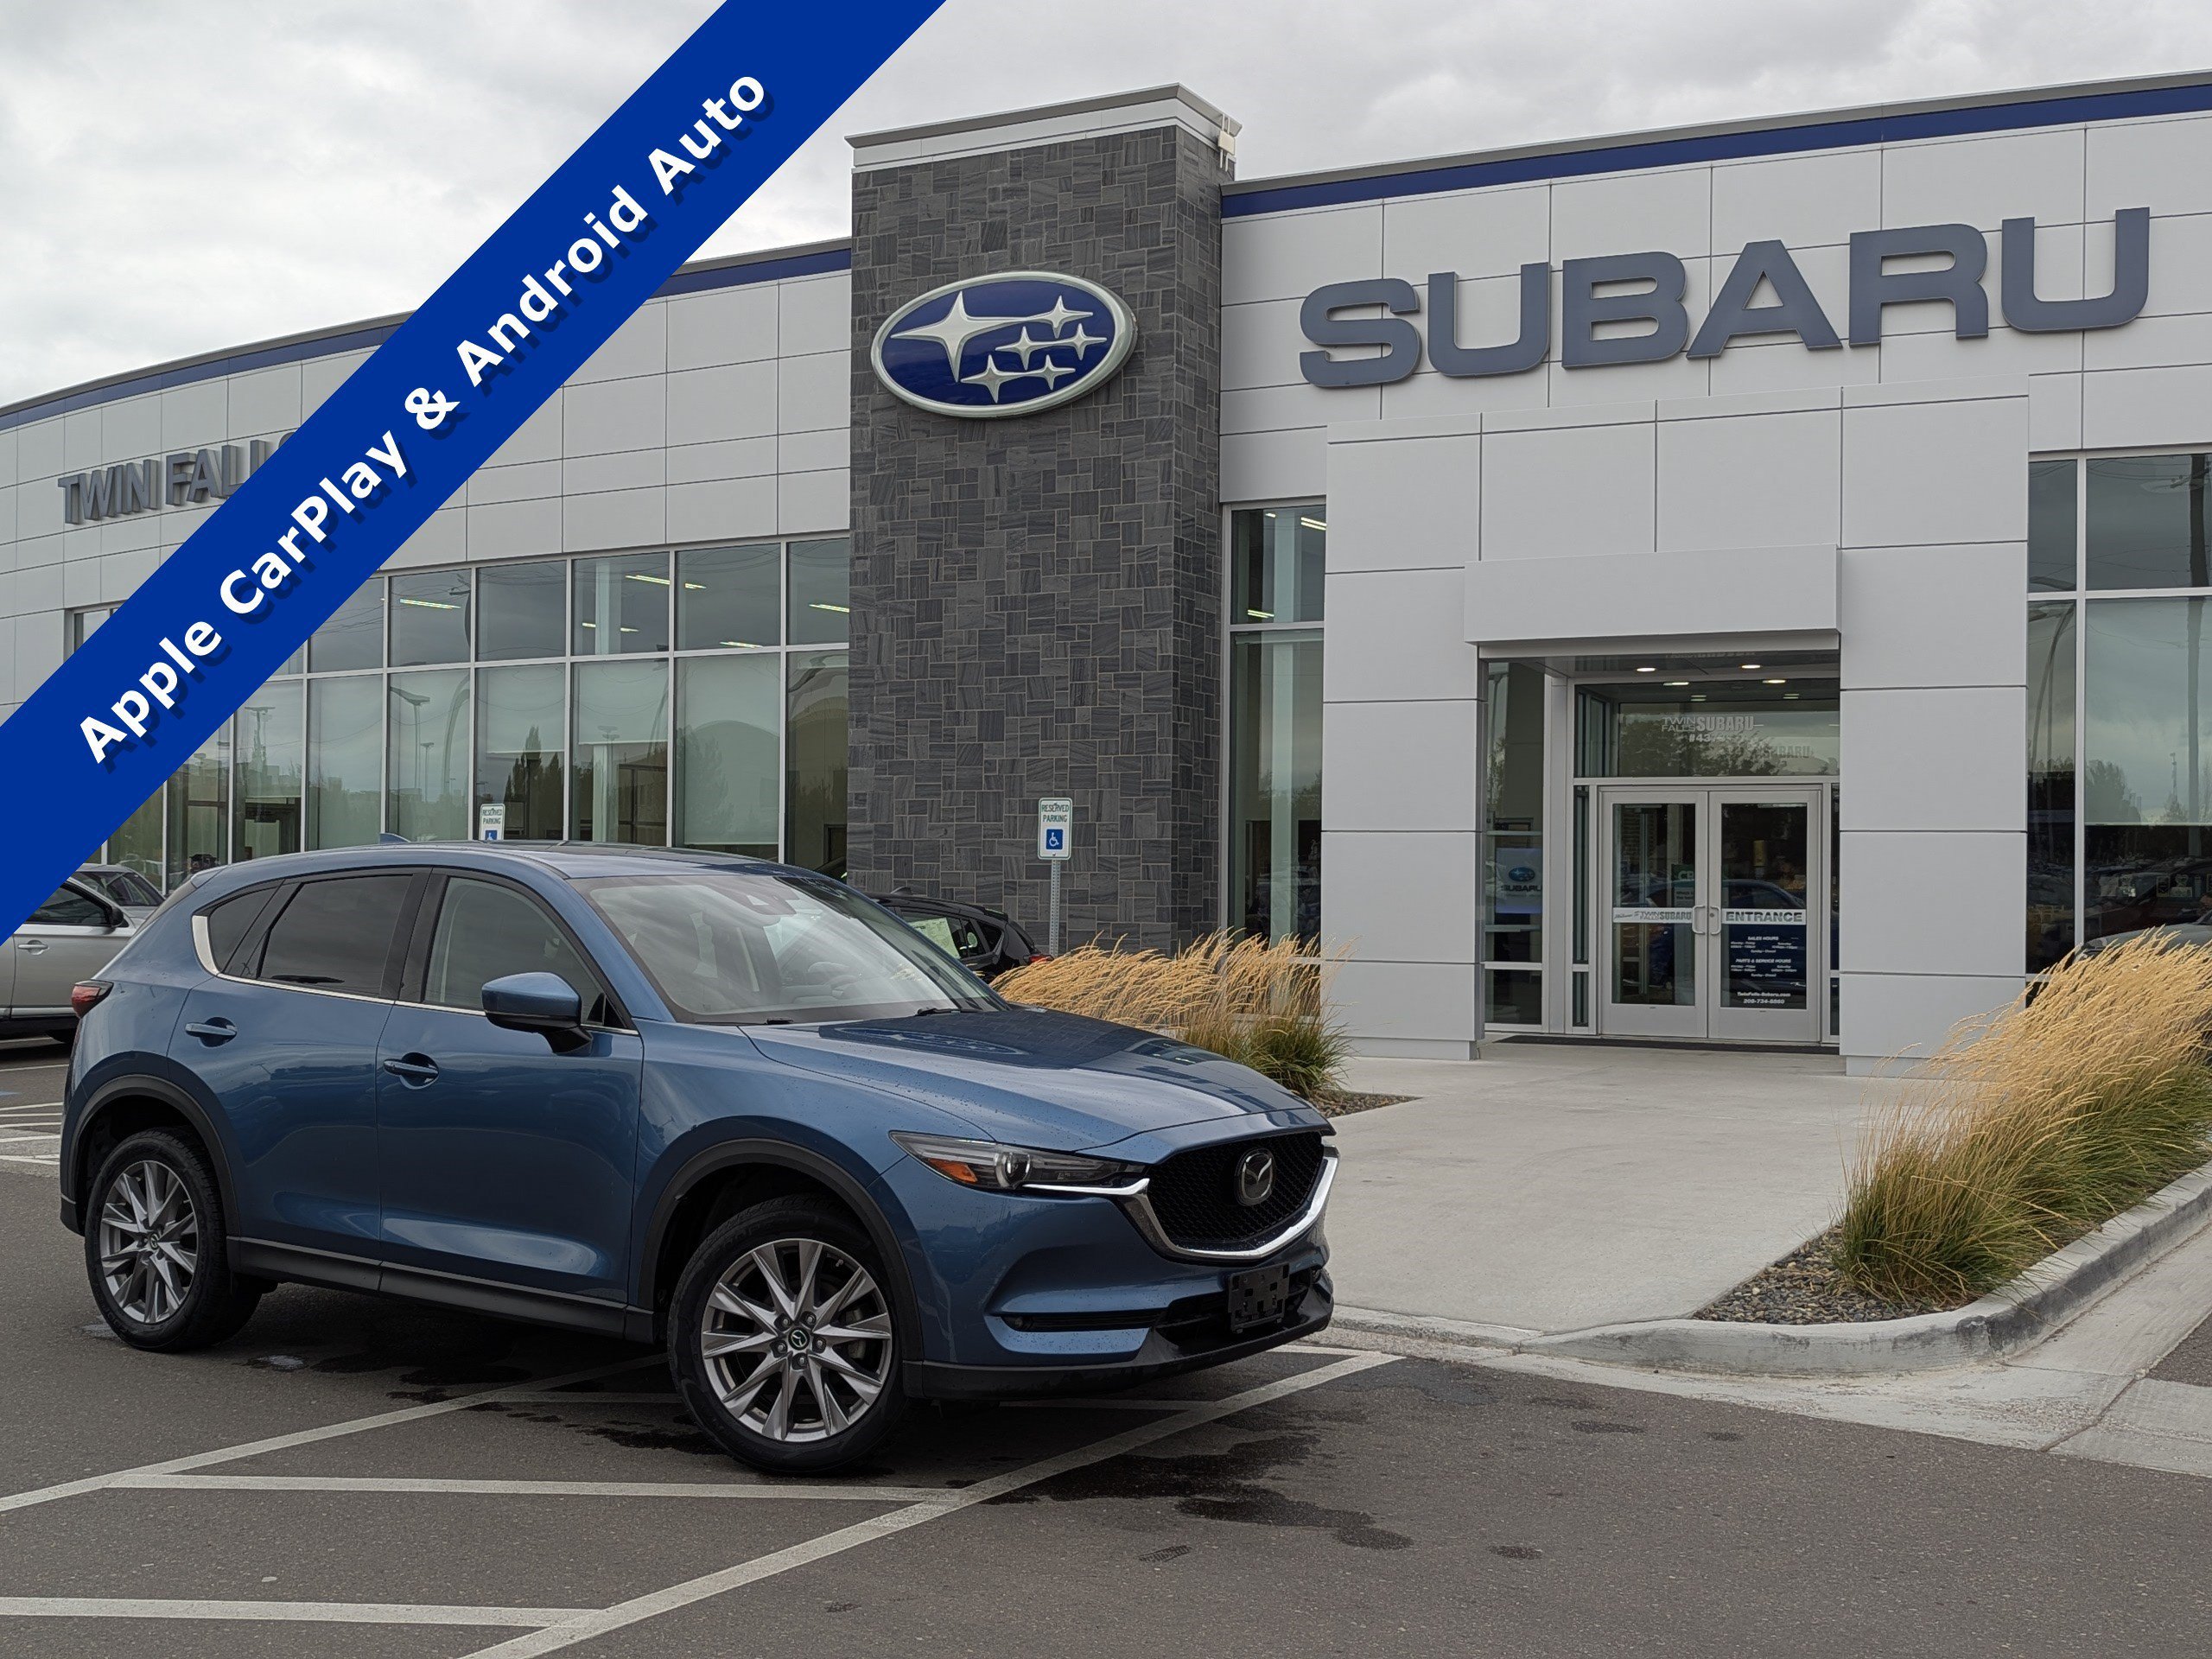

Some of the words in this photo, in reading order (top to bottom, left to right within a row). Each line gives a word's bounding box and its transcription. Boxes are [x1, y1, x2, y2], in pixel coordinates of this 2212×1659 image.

[1300, 206, 2151, 389] SUBARU
[58, 458, 162, 525] TWIN
[1662, 716, 1695, 725] TWIN
[1696, 715, 1754, 731] SUBARU
[1042, 814, 1068, 823] PARKING
[1659, 911, 1692, 920] SUBARU
[1726, 911, 1802, 922] ENTRANCE
